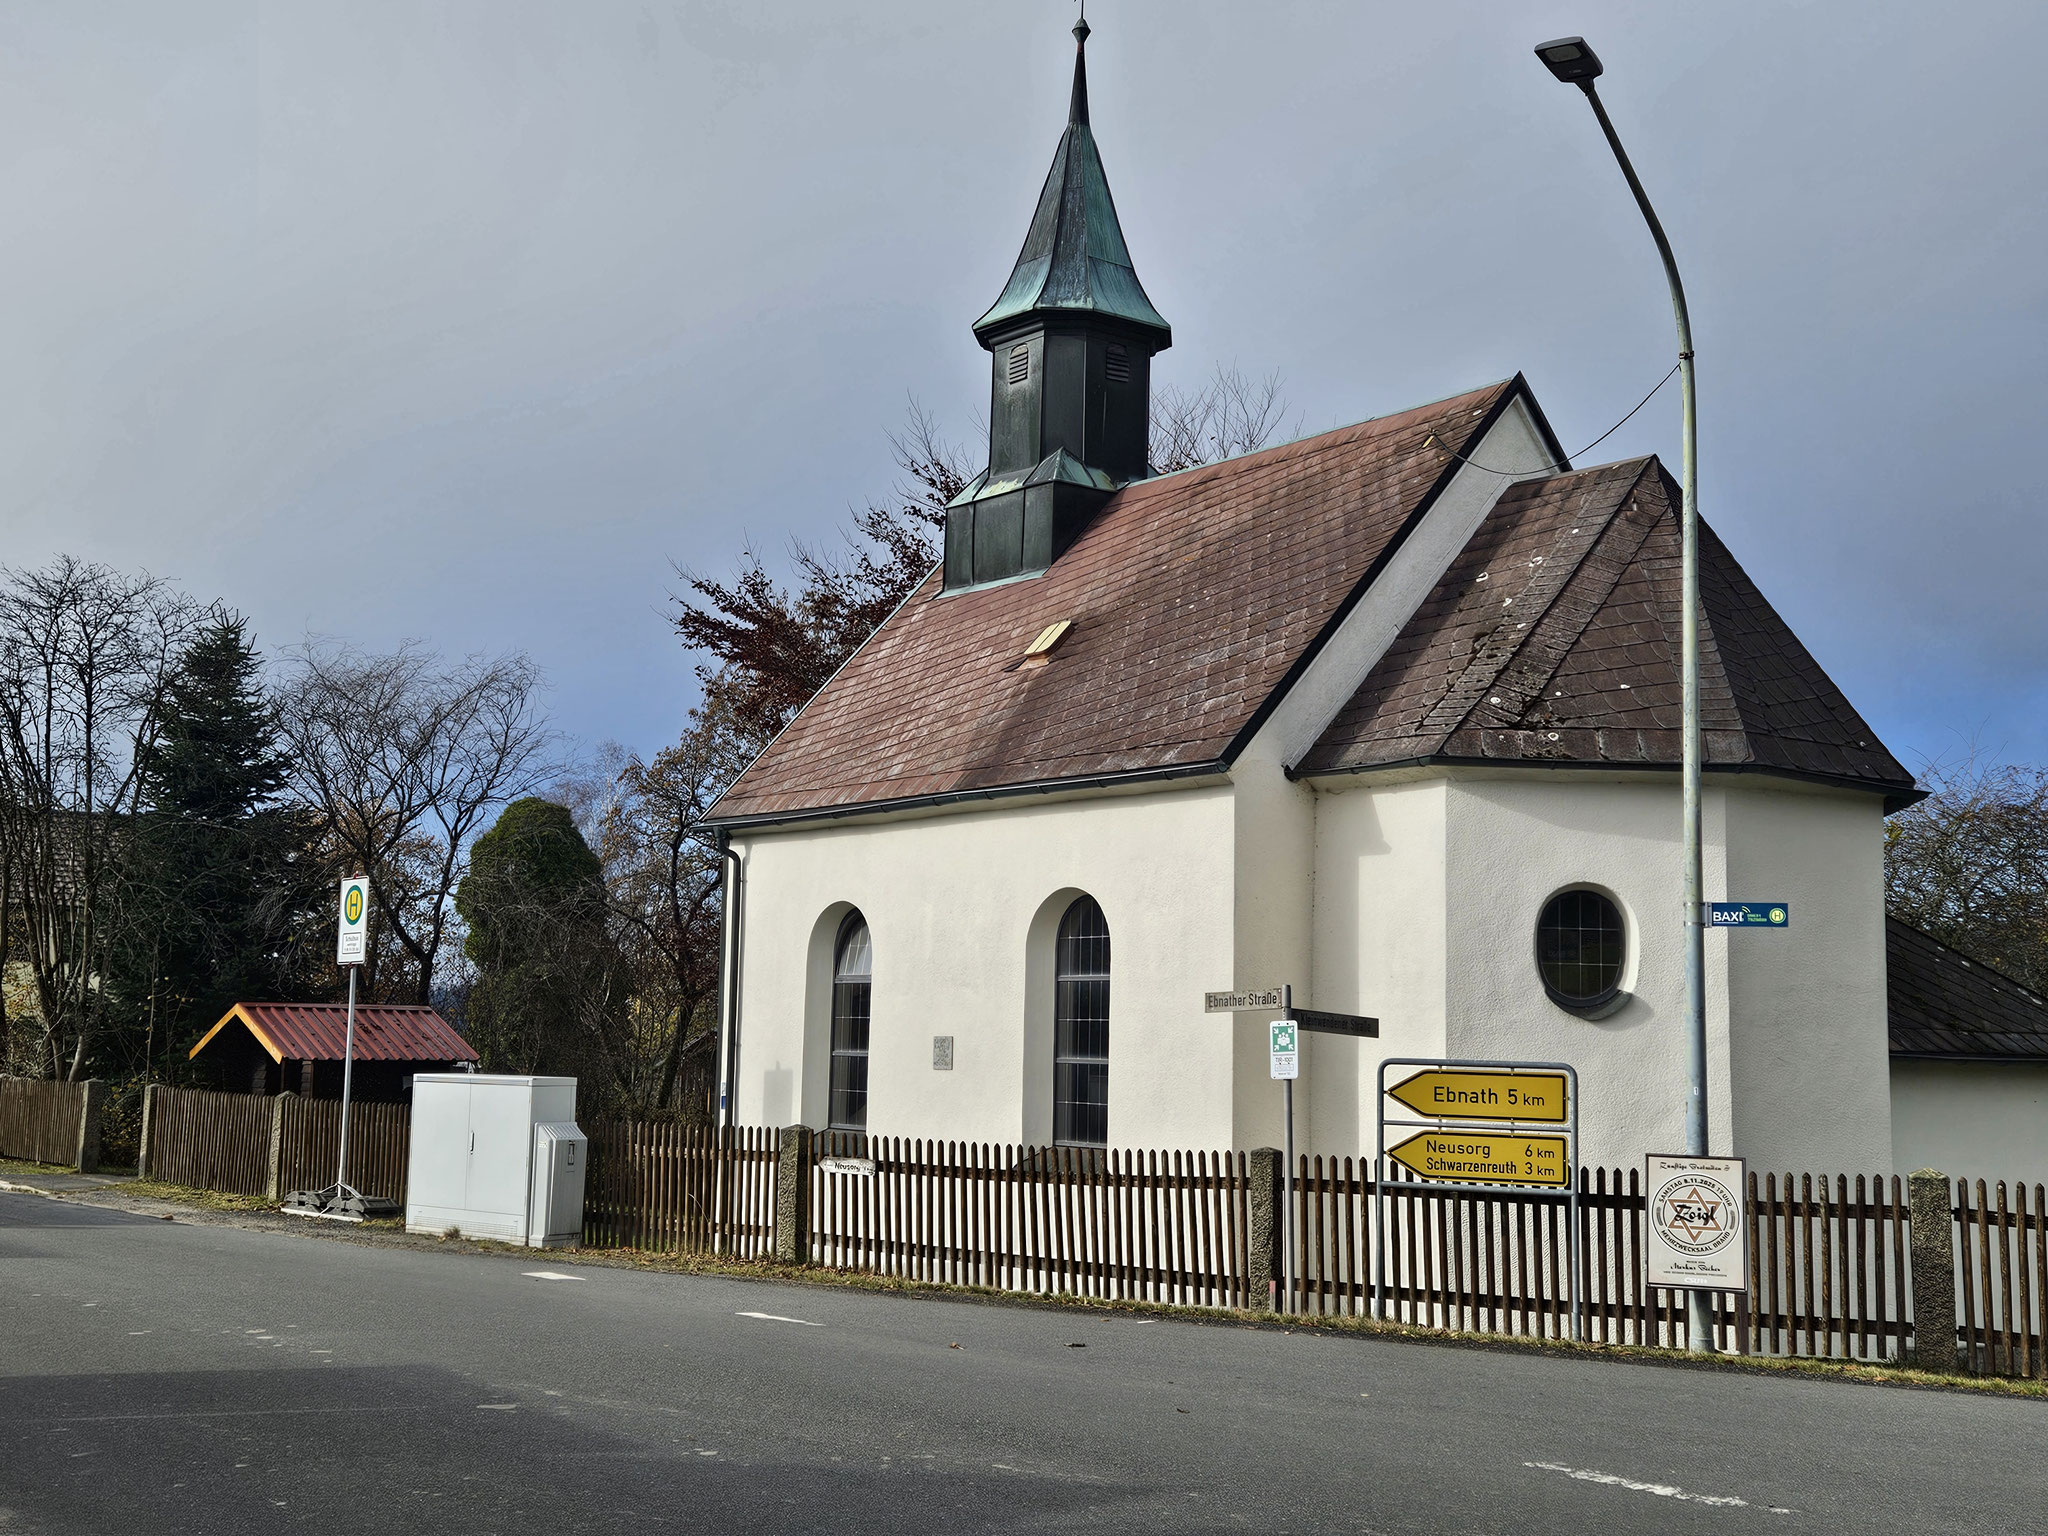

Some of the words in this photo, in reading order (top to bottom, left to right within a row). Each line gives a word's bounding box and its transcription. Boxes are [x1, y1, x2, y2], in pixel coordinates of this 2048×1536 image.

[1208, 994, 1246, 1008] Ebnather
[1248, 992, 1277, 1006] Straße
[1350, 1019, 1372, 1033] Straße
[1433, 1086, 1498, 1104] Ebnath
[1507, 1089, 1518, 1105] 5
[1523, 1093, 1545, 1106] km
[1426, 1140, 1491, 1158] Neusorg
[1524, 1144, 1533, 1158] 6
[1537, 1148, 1555, 1159] km
[1426, 1157, 1517, 1174] Schwarzenreuth
[1524, 1162, 1533, 1175] 3
[1537, 1166, 1555, 1176] km
[1659, 1180, 1683, 1203] SAMSTAG
[1722, 1193, 1733, 1207] UHR
[1674, 1204, 1716, 1226] Zoigl
[1661, 1229, 1713, 1253] MEHRZWECKSAAL
[1712, 1231, 1731, 1248] BRAND
